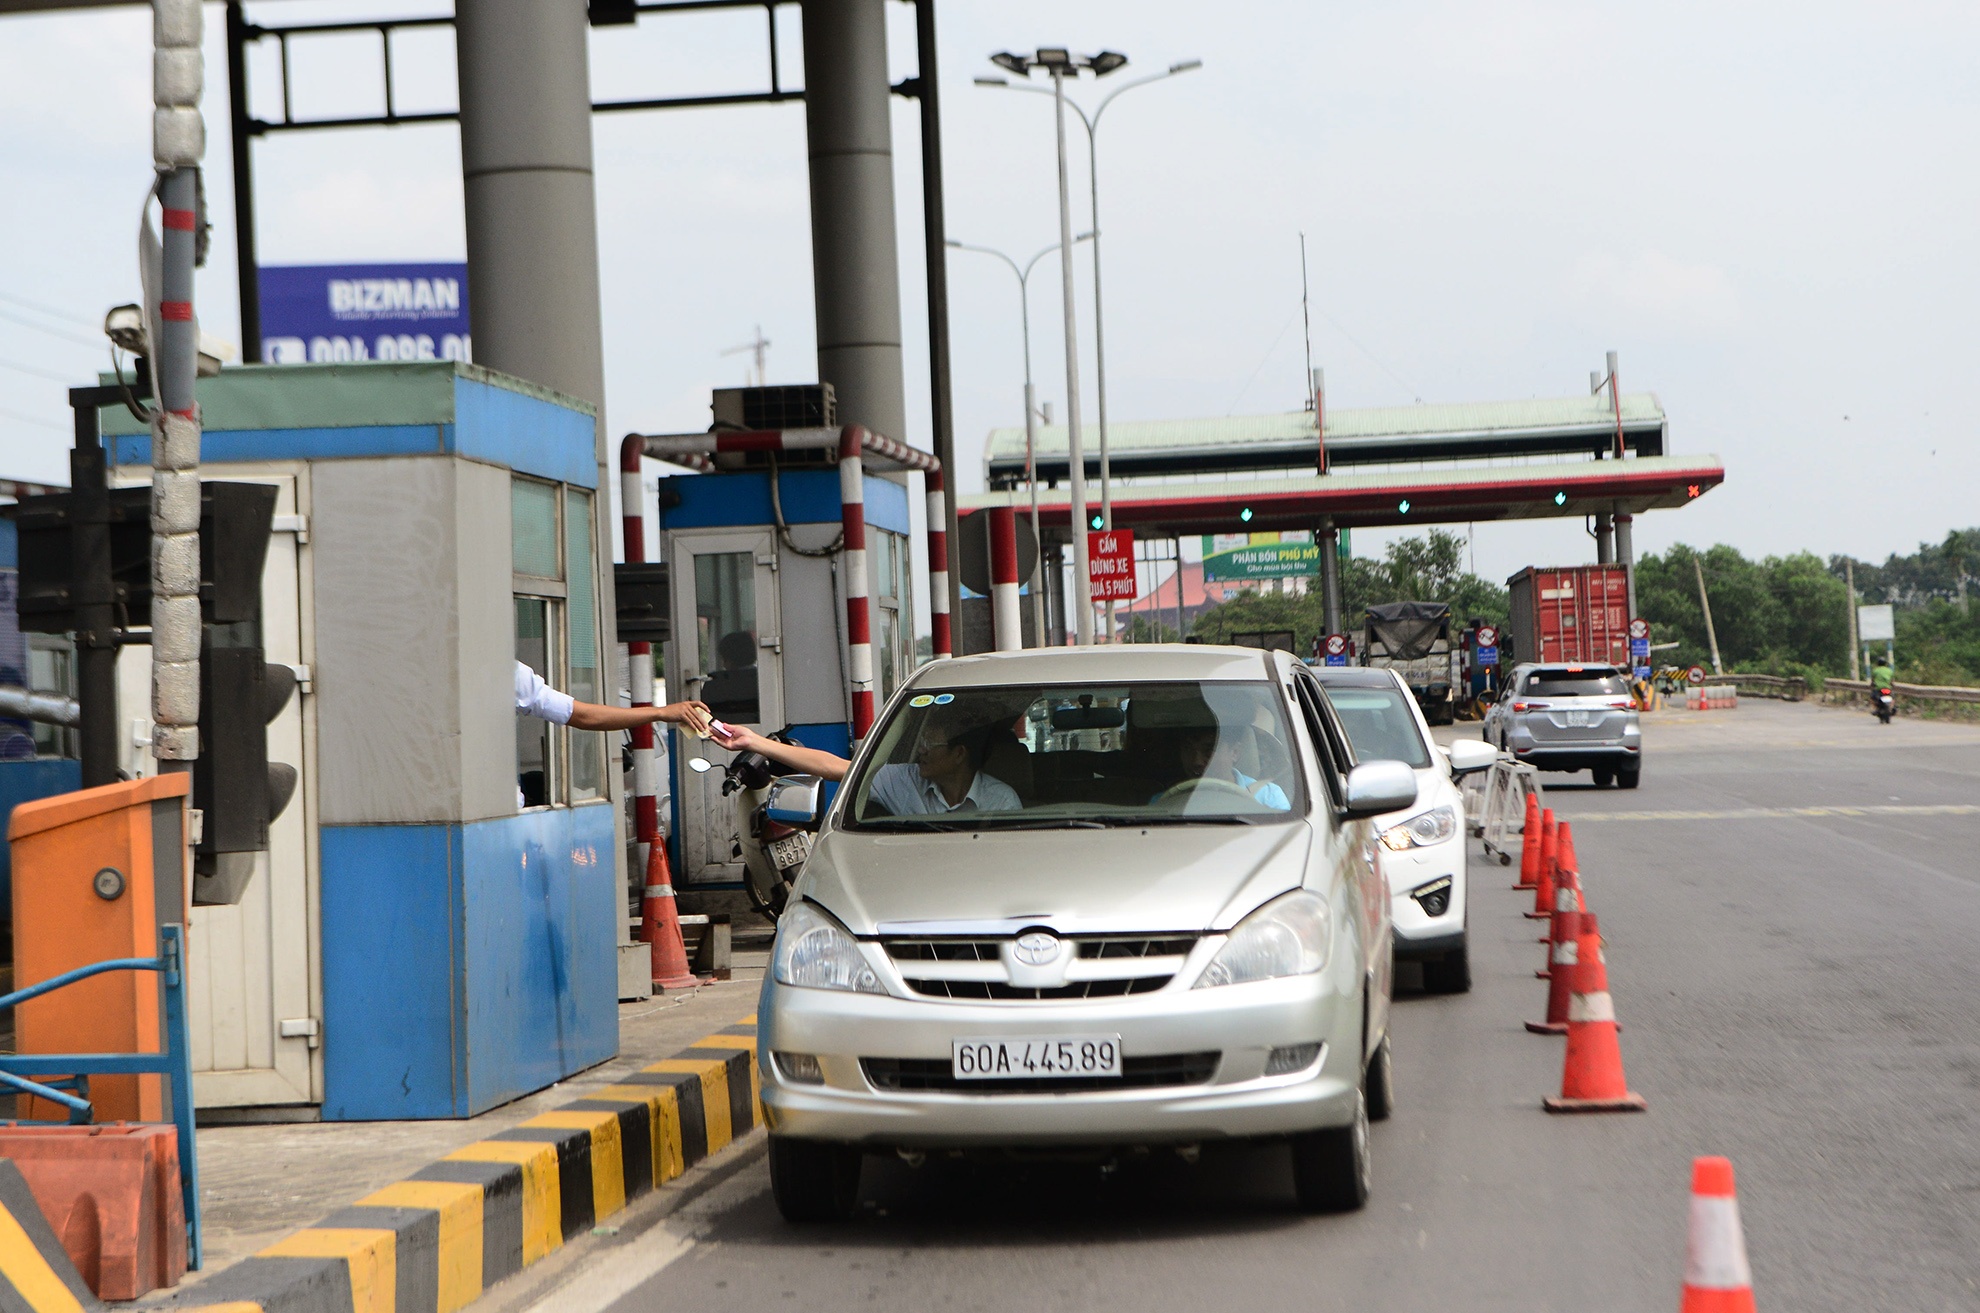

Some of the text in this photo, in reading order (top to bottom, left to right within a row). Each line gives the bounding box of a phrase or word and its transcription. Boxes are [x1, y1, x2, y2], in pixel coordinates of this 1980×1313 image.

[330, 278, 460, 312] BIZMAN
[1098, 533, 1118, 554] CẤM
[1279, 547, 1301, 561] PHÚ
[1090, 556, 1129, 575] DỪNG XE
[1106, 580, 1112, 596] 5
[1113, 576, 1134, 595] PHÚT
[774, 834, 804, 855] 60-L1
[779, 847, 808, 867] 9871
[959, 1041, 1115, 1074] 60A-445.89
